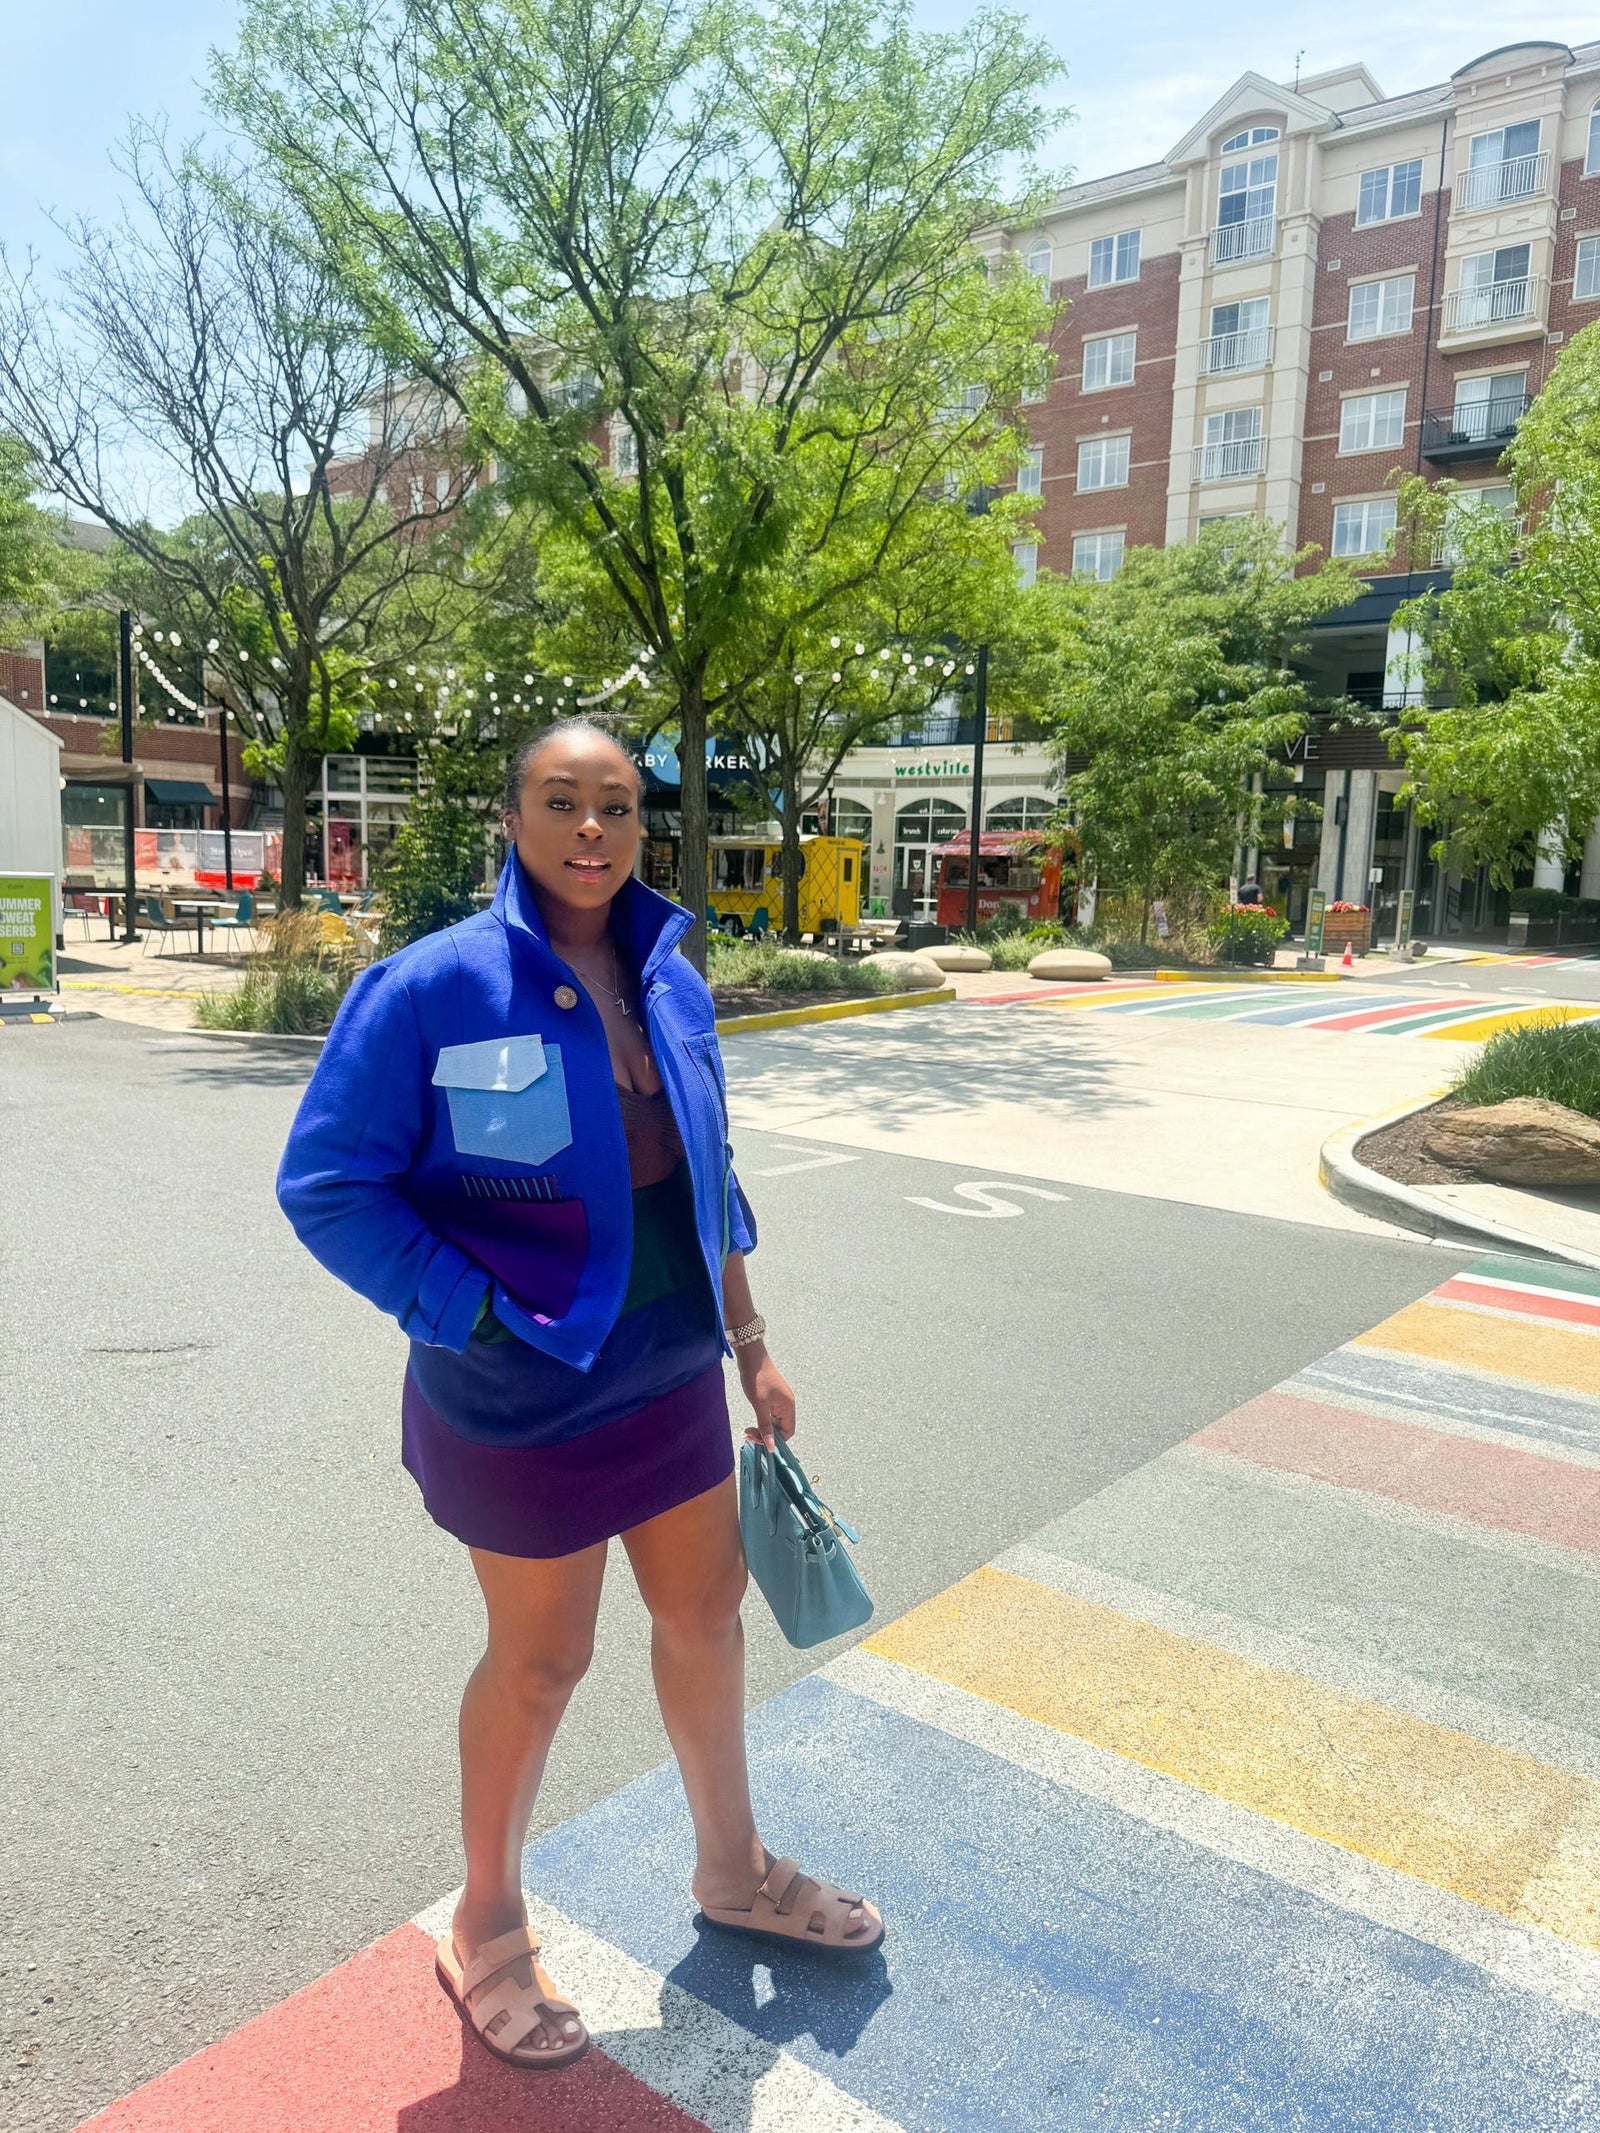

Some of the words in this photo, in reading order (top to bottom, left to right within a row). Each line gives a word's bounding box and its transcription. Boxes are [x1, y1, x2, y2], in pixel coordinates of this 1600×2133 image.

[705, 756, 750, 769] RKER
[895, 761, 970, 776] westville
[903, 827, 921, 835] brunch
[0, 897, 41, 911] UMMER
[0, 911, 36, 924] SWEAT
[0, 925, 36, 937] SERIES
